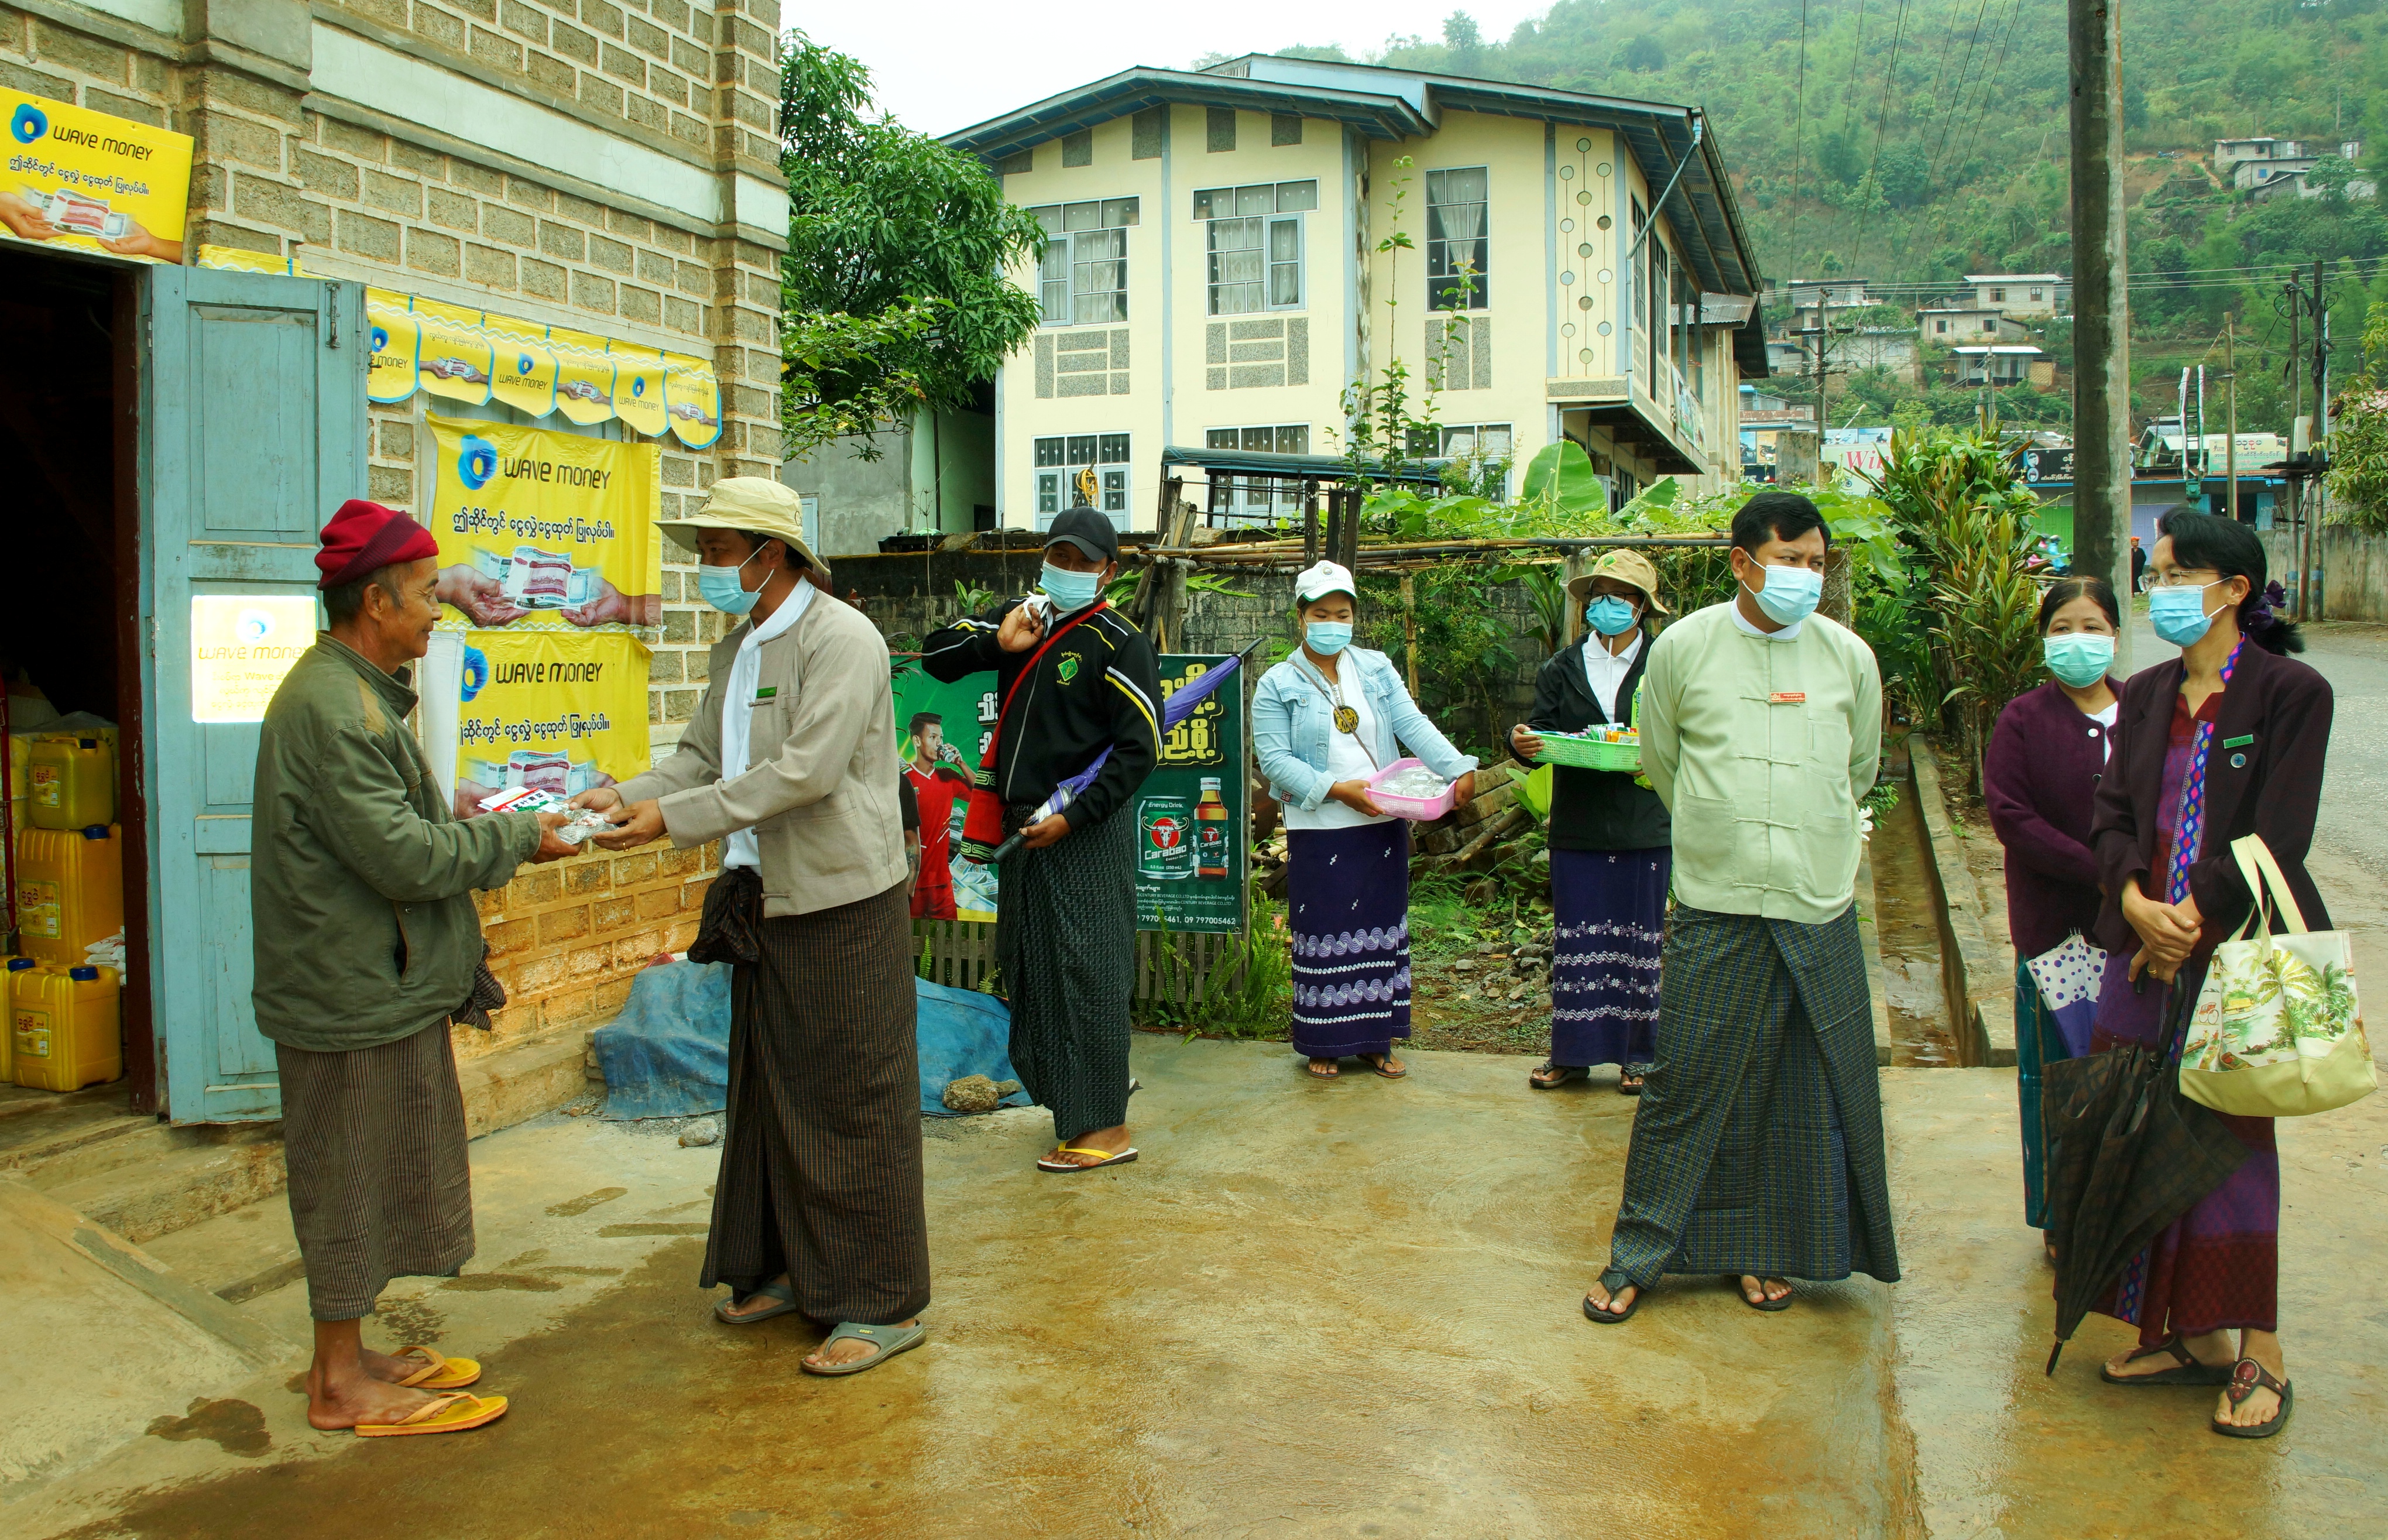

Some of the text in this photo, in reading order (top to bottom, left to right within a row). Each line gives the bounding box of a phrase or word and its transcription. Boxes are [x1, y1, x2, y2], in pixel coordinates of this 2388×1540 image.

[1200, 840, 1222, 848] Carabao
[1145, 845, 1186, 860] Carabao
[1142, 915, 1182, 923] 79705461,
[1196, 917, 1236, 925] 797005462
